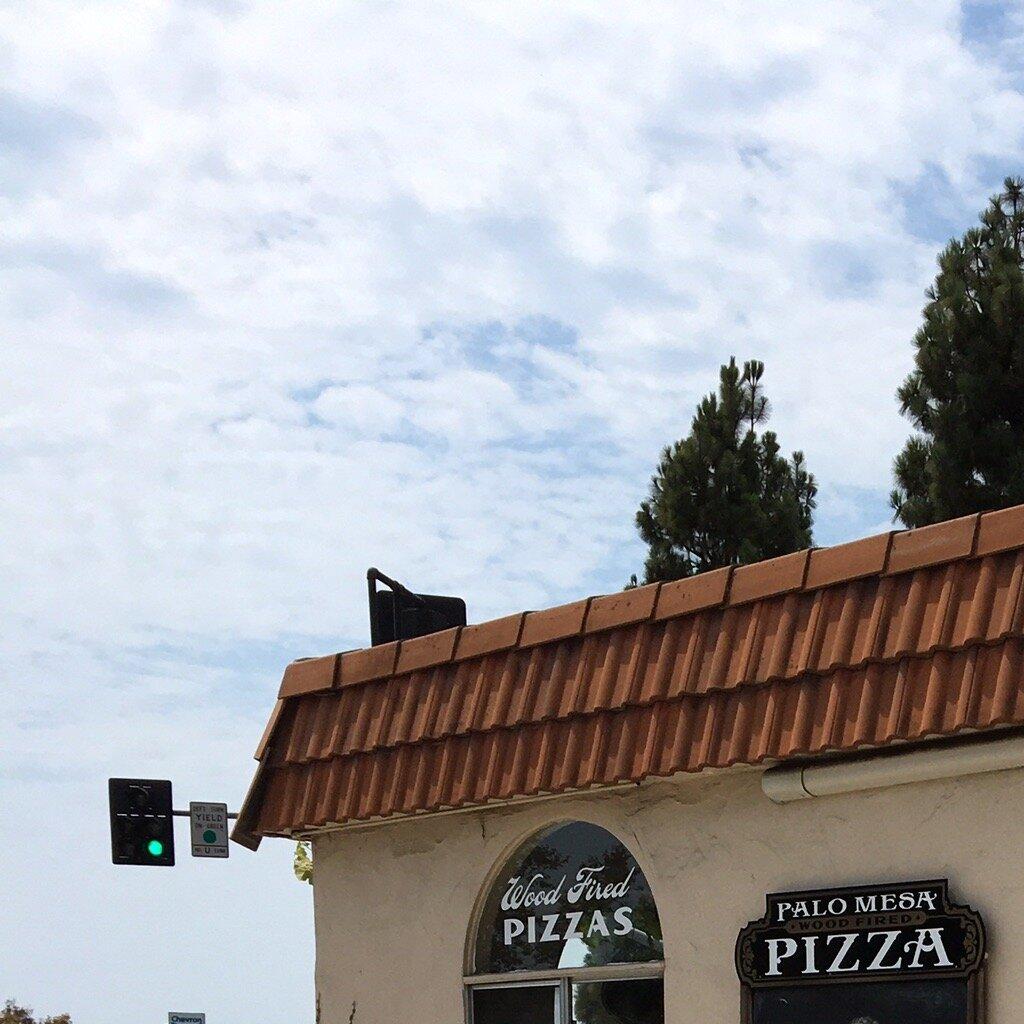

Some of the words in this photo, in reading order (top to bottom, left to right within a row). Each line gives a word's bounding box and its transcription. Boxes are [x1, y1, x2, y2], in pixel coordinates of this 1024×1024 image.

[195, 813, 223, 822] YIELD
[501, 874, 566, 911] Wood
[567, 866, 635, 903] Fired
[777, 898, 847, 921] PALO
[854, 890, 938, 913] MESA
[503, 906, 633, 945] PIZZAS
[800, 918, 850, 930] WOOD
[856, 913, 912, 926] FIRED
[764, 927, 953, 976] PIZZA
[171, 1015, 202, 1023] Chevron
